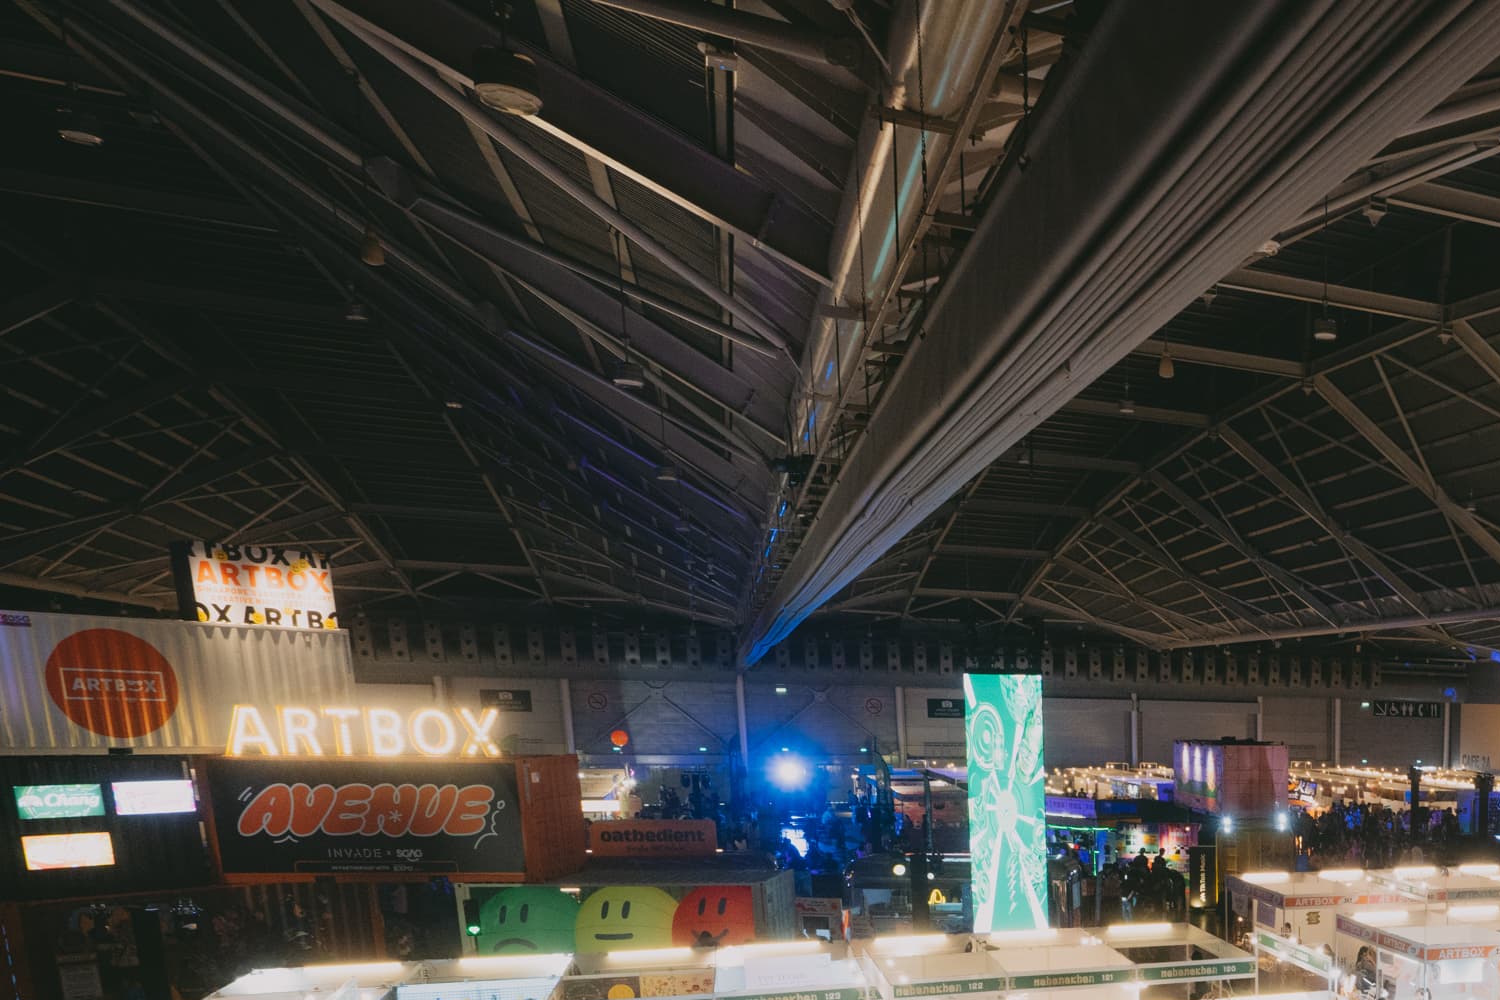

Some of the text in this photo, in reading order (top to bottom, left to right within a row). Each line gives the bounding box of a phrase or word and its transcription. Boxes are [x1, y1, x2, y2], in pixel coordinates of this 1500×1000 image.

[197, 560, 331, 593] ARTBOX
[226, 703, 501, 758] ARTBOX
[43, 793, 100, 808] Chang
[238, 783, 495, 837] AVENUE
[600, 828, 705, 843] oatbedient
[327, 848, 384, 859] INVADE
[1295, 896, 1334, 907] ARTBOX
[1439, 946, 1485, 960] ARTBOX
